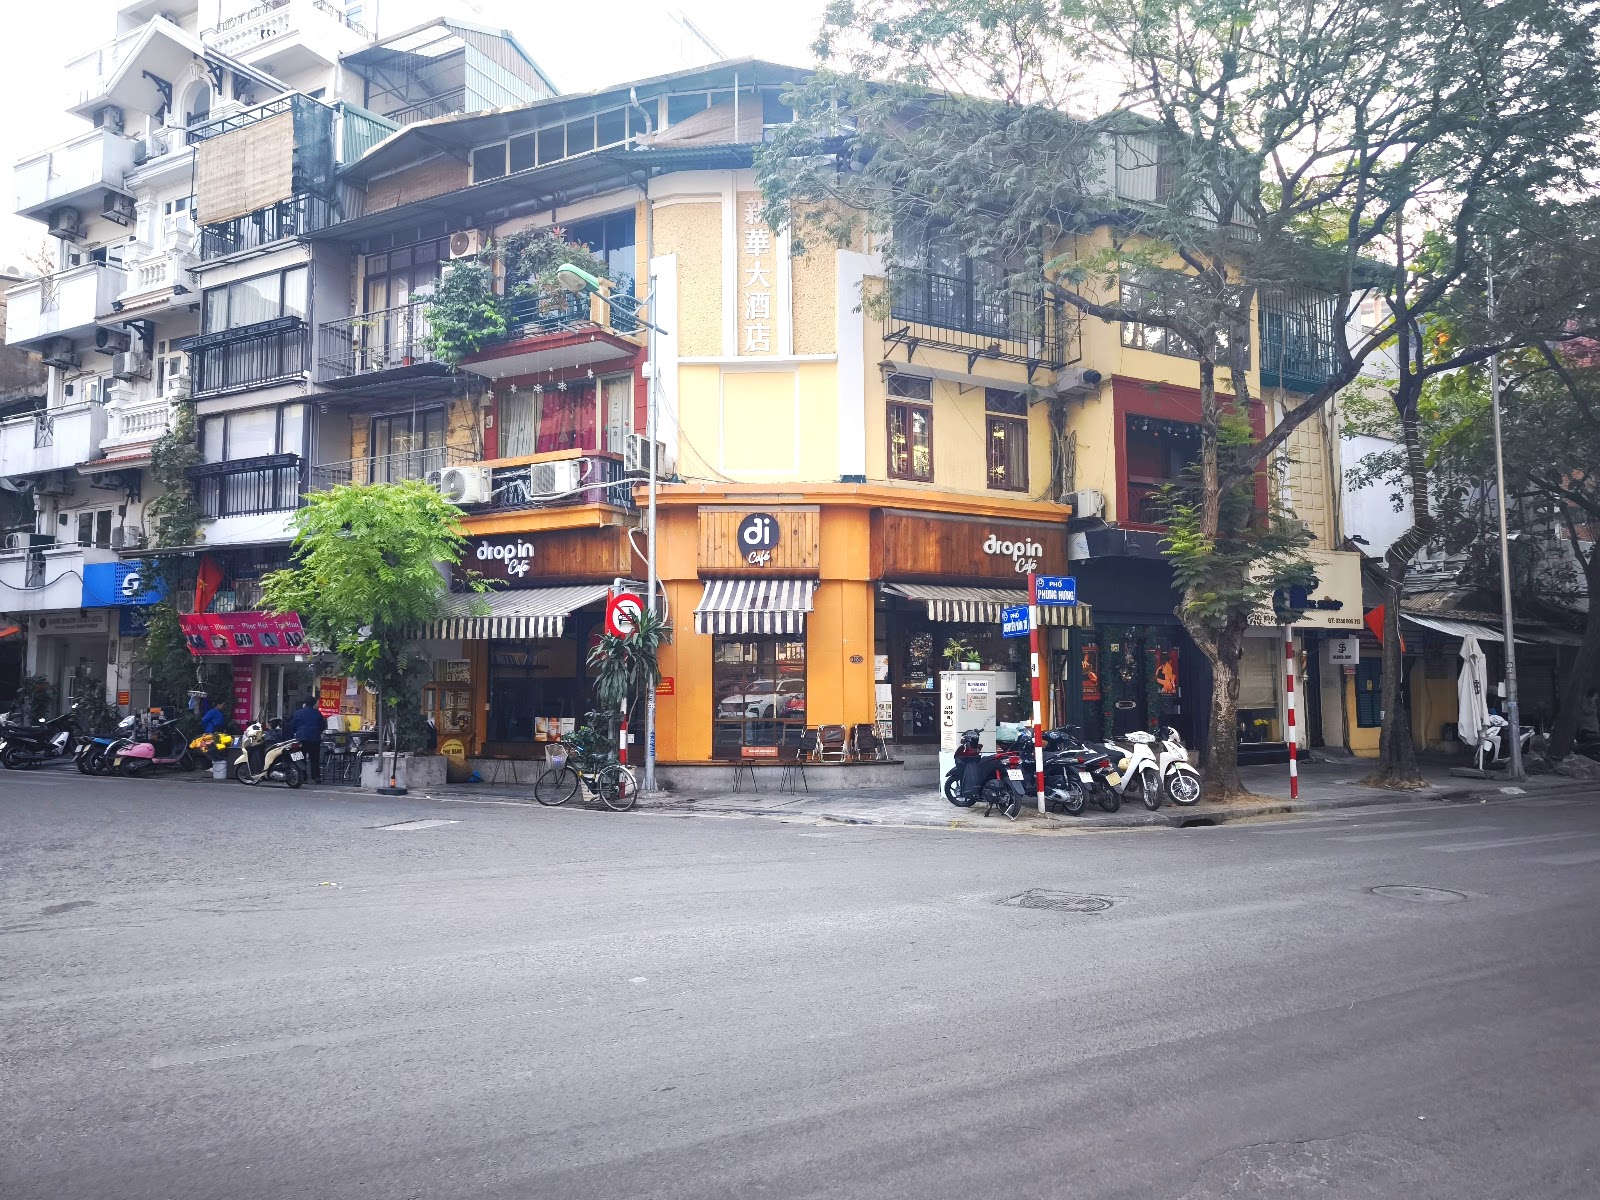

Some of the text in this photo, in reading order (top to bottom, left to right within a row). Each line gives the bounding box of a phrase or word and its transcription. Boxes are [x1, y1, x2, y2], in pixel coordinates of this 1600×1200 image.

[743, 517, 770, 545] di
[748, 549, 771, 567] Café
[321, 699, 336, 708] 20K
